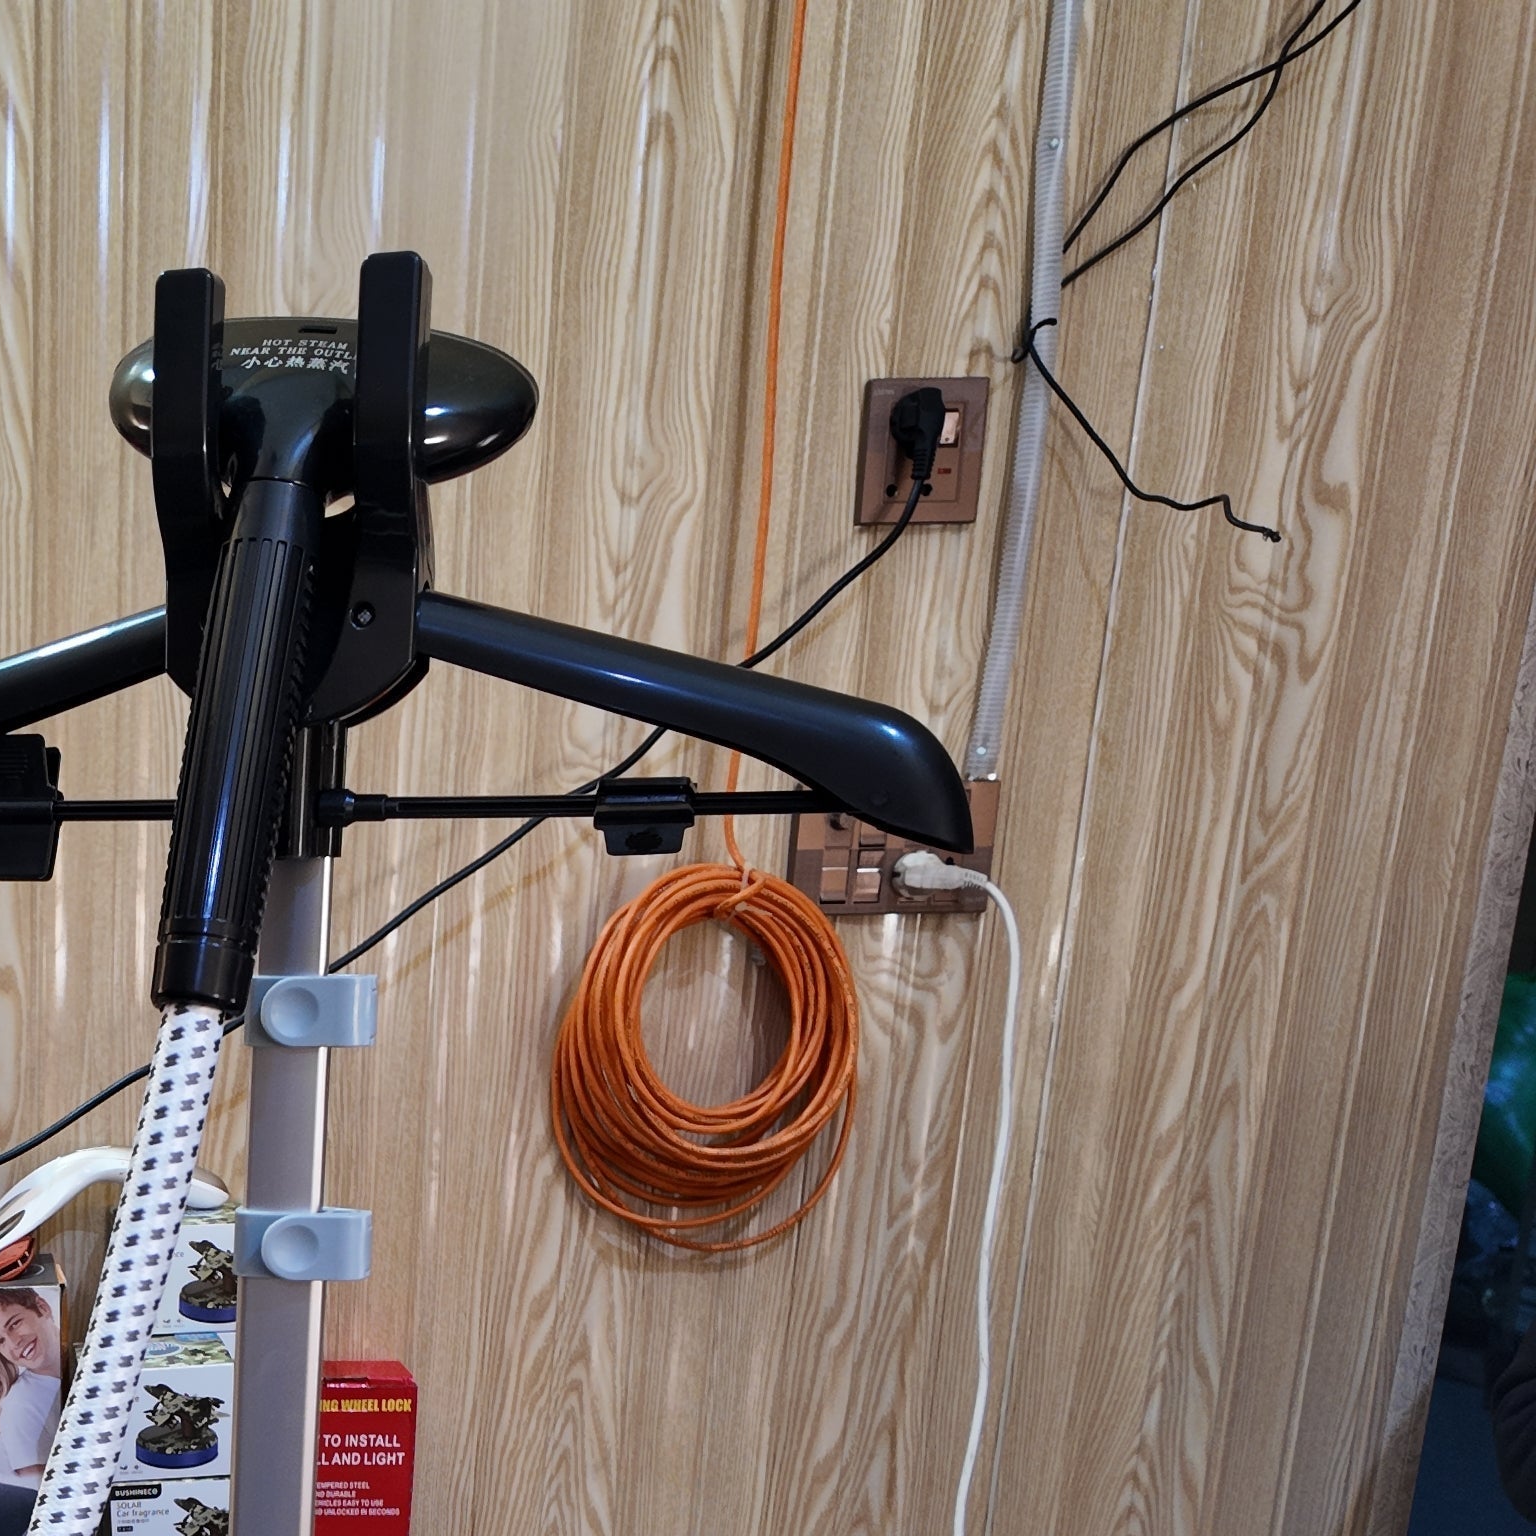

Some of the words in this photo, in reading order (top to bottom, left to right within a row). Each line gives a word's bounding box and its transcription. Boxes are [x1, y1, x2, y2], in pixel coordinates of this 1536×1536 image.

[262, 339, 293, 347] HOT
[298, 339, 349, 350] STEAM
[230, 347, 271, 356] NEAR
[278, 346, 307, 355] THE
[314, 348, 357, 360] OUTL
[340, 1399, 380, 1413] WHEEL
[381, 1399, 412, 1412] LOCK
[322, 1434, 342, 1448] TO
[345, 1434, 401, 1448] INSTALL
[331, 1452, 361, 1466] AND
[363, 1452, 406, 1466] LIGHT
[349, 1481, 370, 1489] STEEL
